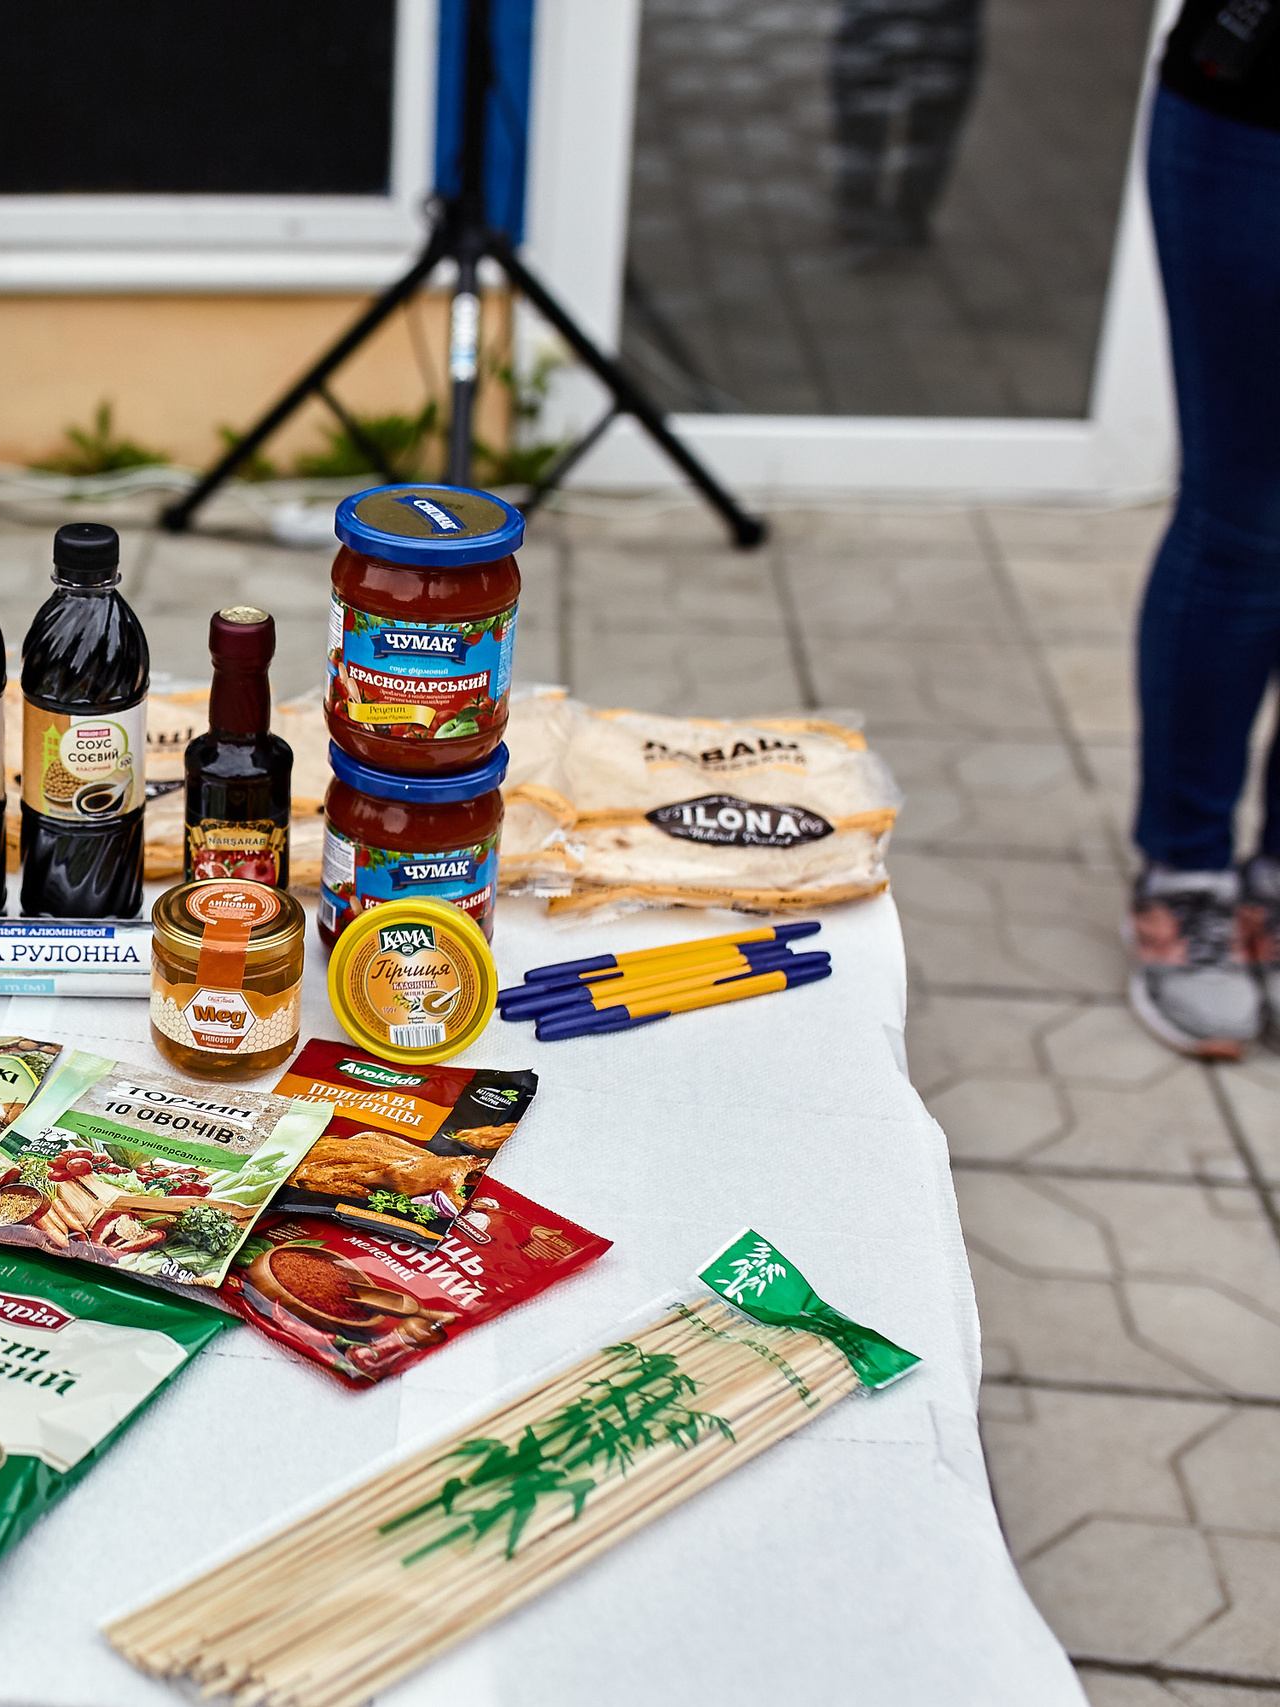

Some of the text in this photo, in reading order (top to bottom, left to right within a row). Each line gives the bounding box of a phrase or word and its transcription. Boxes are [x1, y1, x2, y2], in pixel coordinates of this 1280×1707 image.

[384, 632, 458, 653] ЧУМАК
[348, 665, 488, 695] КРАСНОДАРСЬКИЙ
[67, 748, 119, 763] СОЄВИЙ
[76, 739, 112, 750] СОУС
[681, 805, 802, 837] ILONA
[403, 860, 470, 880] ЧУМАК
[28, 927, 107, 938] АЛЮМІНІЄВОЇ
[11, 944, 141, 963] РУЛОННА
[370, 959, 451, 984] Гірчиця
[128, 1086, 253, 1119] ТОРЧИН
[308, 1082, 417, 1111] ПРИПРАВА
[104, 1101, 235, 1144] 10 ОВОЧІВ
[334, 1099, 424, 1127] КУРИЦЫ
[88, 1125, 213, 1164] приправа універсальна
[161, 1261, 178, 1277] 60
[342, 1236, 420, 1283] мелений
